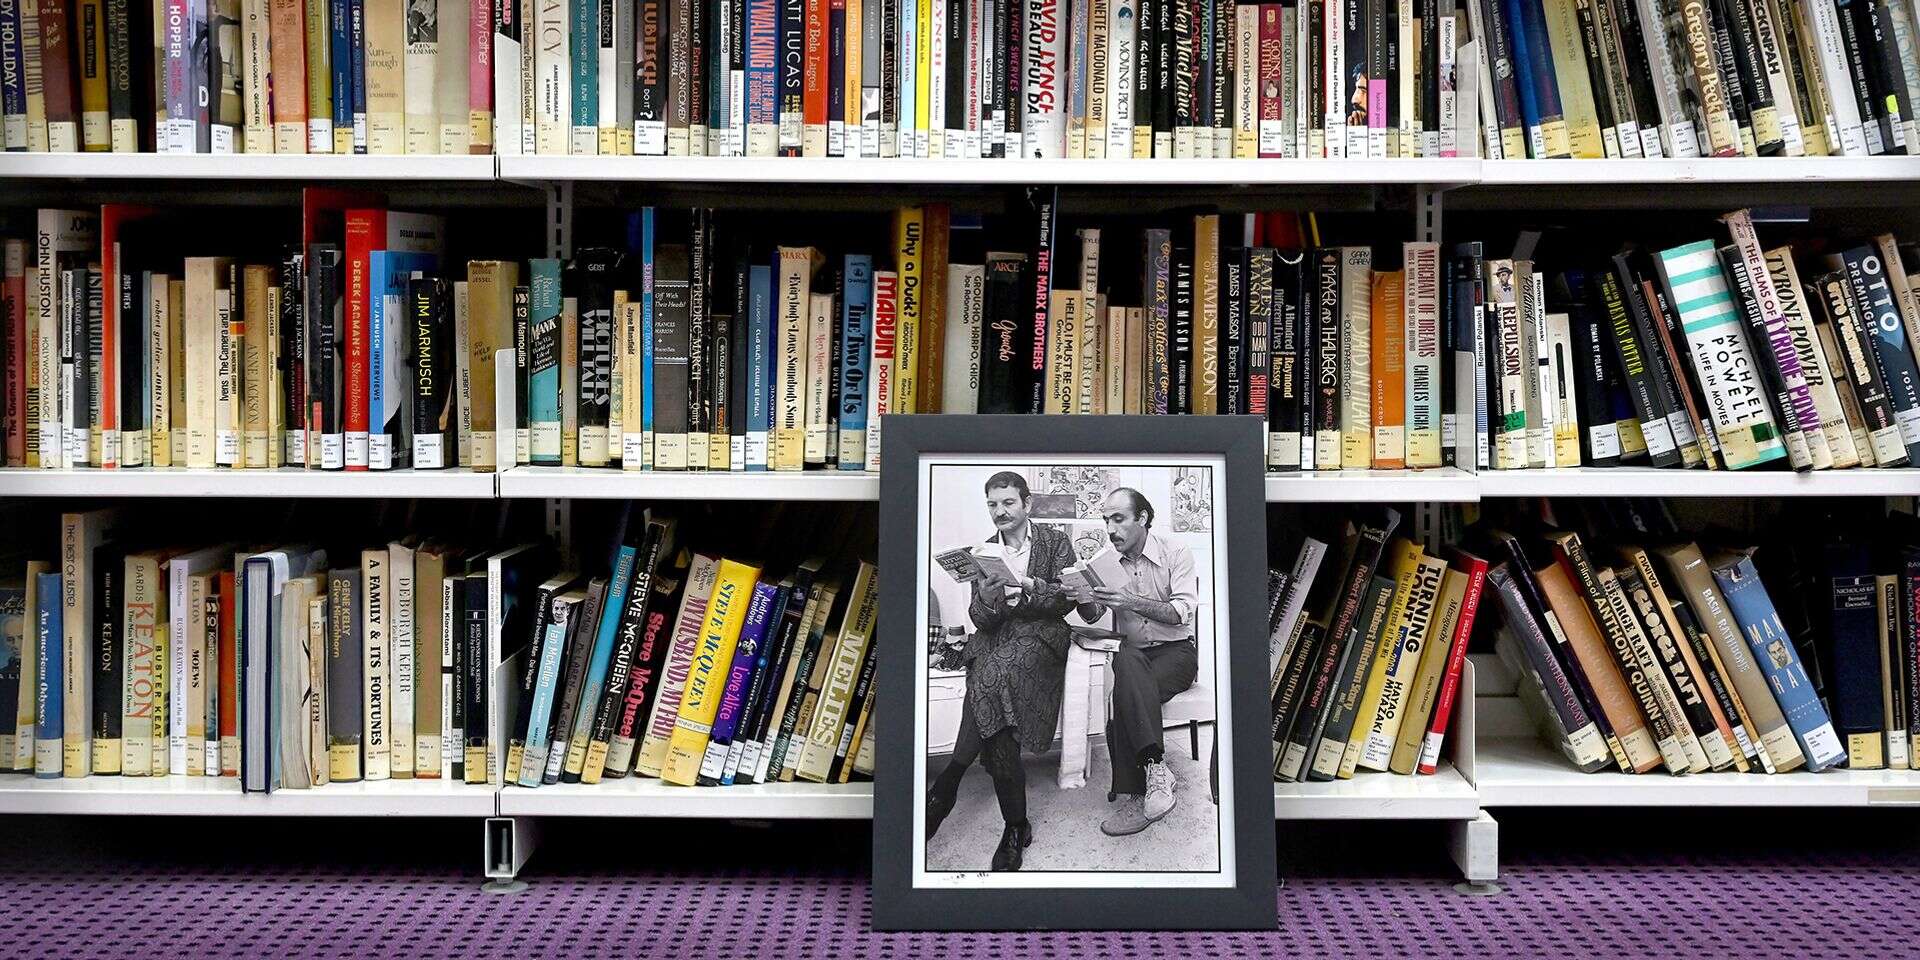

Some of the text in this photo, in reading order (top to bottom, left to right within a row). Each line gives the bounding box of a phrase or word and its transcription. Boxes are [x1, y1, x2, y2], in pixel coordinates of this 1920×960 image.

[169, 4, 182, 58] HOPPER
[476, 15, 489, 30] my
[602, 4, 612, 44] Lubitsch
[643, 2, 657, 85] LUBITSCH
[732, 14, 743, 63] companion
[884, 11, 894, 42] LUMET
[1028, 1, 1042, 87] BEAUTIFUL
[1201, 8, 1211, 61] MacLaine
[1348, 0, 1357, 31] at Large
[1444, 20, 1452, 60] Mamoulian
[1585, 25, 1599, 58] Pasolini
[1603, 25, 1614, 53] Pasolini
[0, 22, 17, 88] HOLLIDAY
[117, 12, 130, 90] HOLLYWOOD
[478, 30, 490, 66] Father
[522, 22, 532, 120] The Intimate Diary of Linda Lovelace
[786, 30, 800, 88] LUCAS
[808, 14, 820, 92] of Bela Lugosi
[883, 50, 893, 88] MAKING
[1092, 33, 1106, 122] MACDONALD STORY
[1118, 40, 1129, 90] MOVING
[1175, 37, 1192, 118] MacLaine
[1214, 19, 1225, 107] Get There From
[1261, 39, 1272, 79] WITHIN
[1271, 39, 1281, 78] GOING
[1333, 72, 1338, 81] of
[1684, 1, 1724, 113] Gregory Peck
[1742, 27, 1766, 103] The Western Films
[1727, 73, 1742, 97] WOMEN
[38, 229, 52, 318] JOHN HUSTON
[901, 222, 920, 318] Why a Duck?
[1249, 254, 1262, 316] MASON
[1260, 253, 1274, 318] JAMES
[1731, 261, 1764, 328] ARROWS DESIRE
[1847, 261, 1879, 337] PREMINGER
[1861, 255, 1900, 333] OTTO
[626, 306, 636, 356] Jayne Mansfield
[690, 228, 703, 426] The Films of FREDRIC MARCH Quirk
[1031, 250, 1049, 371] THE MARX BROTHERS
[1272, 288, 1284, 350] Different Lives
[1284, 304, 1296, 350] A Hundred
[1415, 250, 1436, 358] MERCHANT OF DREAMS
[416, 293, 433, 396] JIM JARMUSCH
[517, 321, 527, 368] Mamoulian
[580, 309, 595, 407] WILL TALK
[594, 308, 611, 406] PICTURES
[874, 276, 897, 402] MARVIN DONALD
[990, 319, 1018, 363] Groucho
[1502, 305, 1521, 377] REPULSION
[1620, 338, 1644, 377] POTTER
[1764, 313, 1806, 381] TYRONE
[41, 336, 51, 419] HOLLYWOOD'S MAGIC
[245, 343, 259, 425] ANNE JACKSON
[784, 355, 800, 404] Somebody
[1249, 374, 1267, 414] SHERIDAN
[1270, 356, 1283, 390] Massey
[1282, 356, 1294, 399] Raymond
[1412, 364, 1430, 402] CHARLES
[1711, 337, 1749, 425] POWELL
[1725, 333, 1764, 419] MICHAEL
[27, 388, 39, 455] JOHN HUSTON
[135, 564, 145, 602] DARDIS
[627, 572, 650, 618] STEVE
[709, 580, 734, 628] STEVE
[745, 588, 764, 626] Meadows
[754, 594, 772, 626] Audrey
[1404, 566, 1443, 654] TURNING
[101, 622, 112, 672] KEATON
[207, 631, 217, 662] Keaton
[369, 559, 382, 746] A FAMILY & ITS FORTUNES
[398, 577, 412, 694] DEBORAH KERR
[638, 611, 665, 663] Steve
[657, 594, 708, 710] MY HUSBAND, MY
[1308, 564, 1370, 709] Robert Mitchum on the Screen
[1569, 542, 1663, 720] The Films of ANTHONY QUINN
[1603, 578, 1654, 669] GEORGE RAFT
[1633, 588, 1702, 706] GEORGE RAFT
[1702, 588, 1751, 673] BASIL RATHBONE
[1747, 612, 1785, 646] MAN
[37, 609, 50, 727] An American Odyssey
[125, 602, 154, 721] KEATON
[154, 645, 163, 698] BUSTER
[540, 629, 562, 689] Ian McKellen
[1771, 662, 1808, 695] RAY
[718, 692, 741, 721] Alice
[1371, 678, 1397, 734] MIYAZAKI
[1384, 681, 1405, 720] HAYAO
